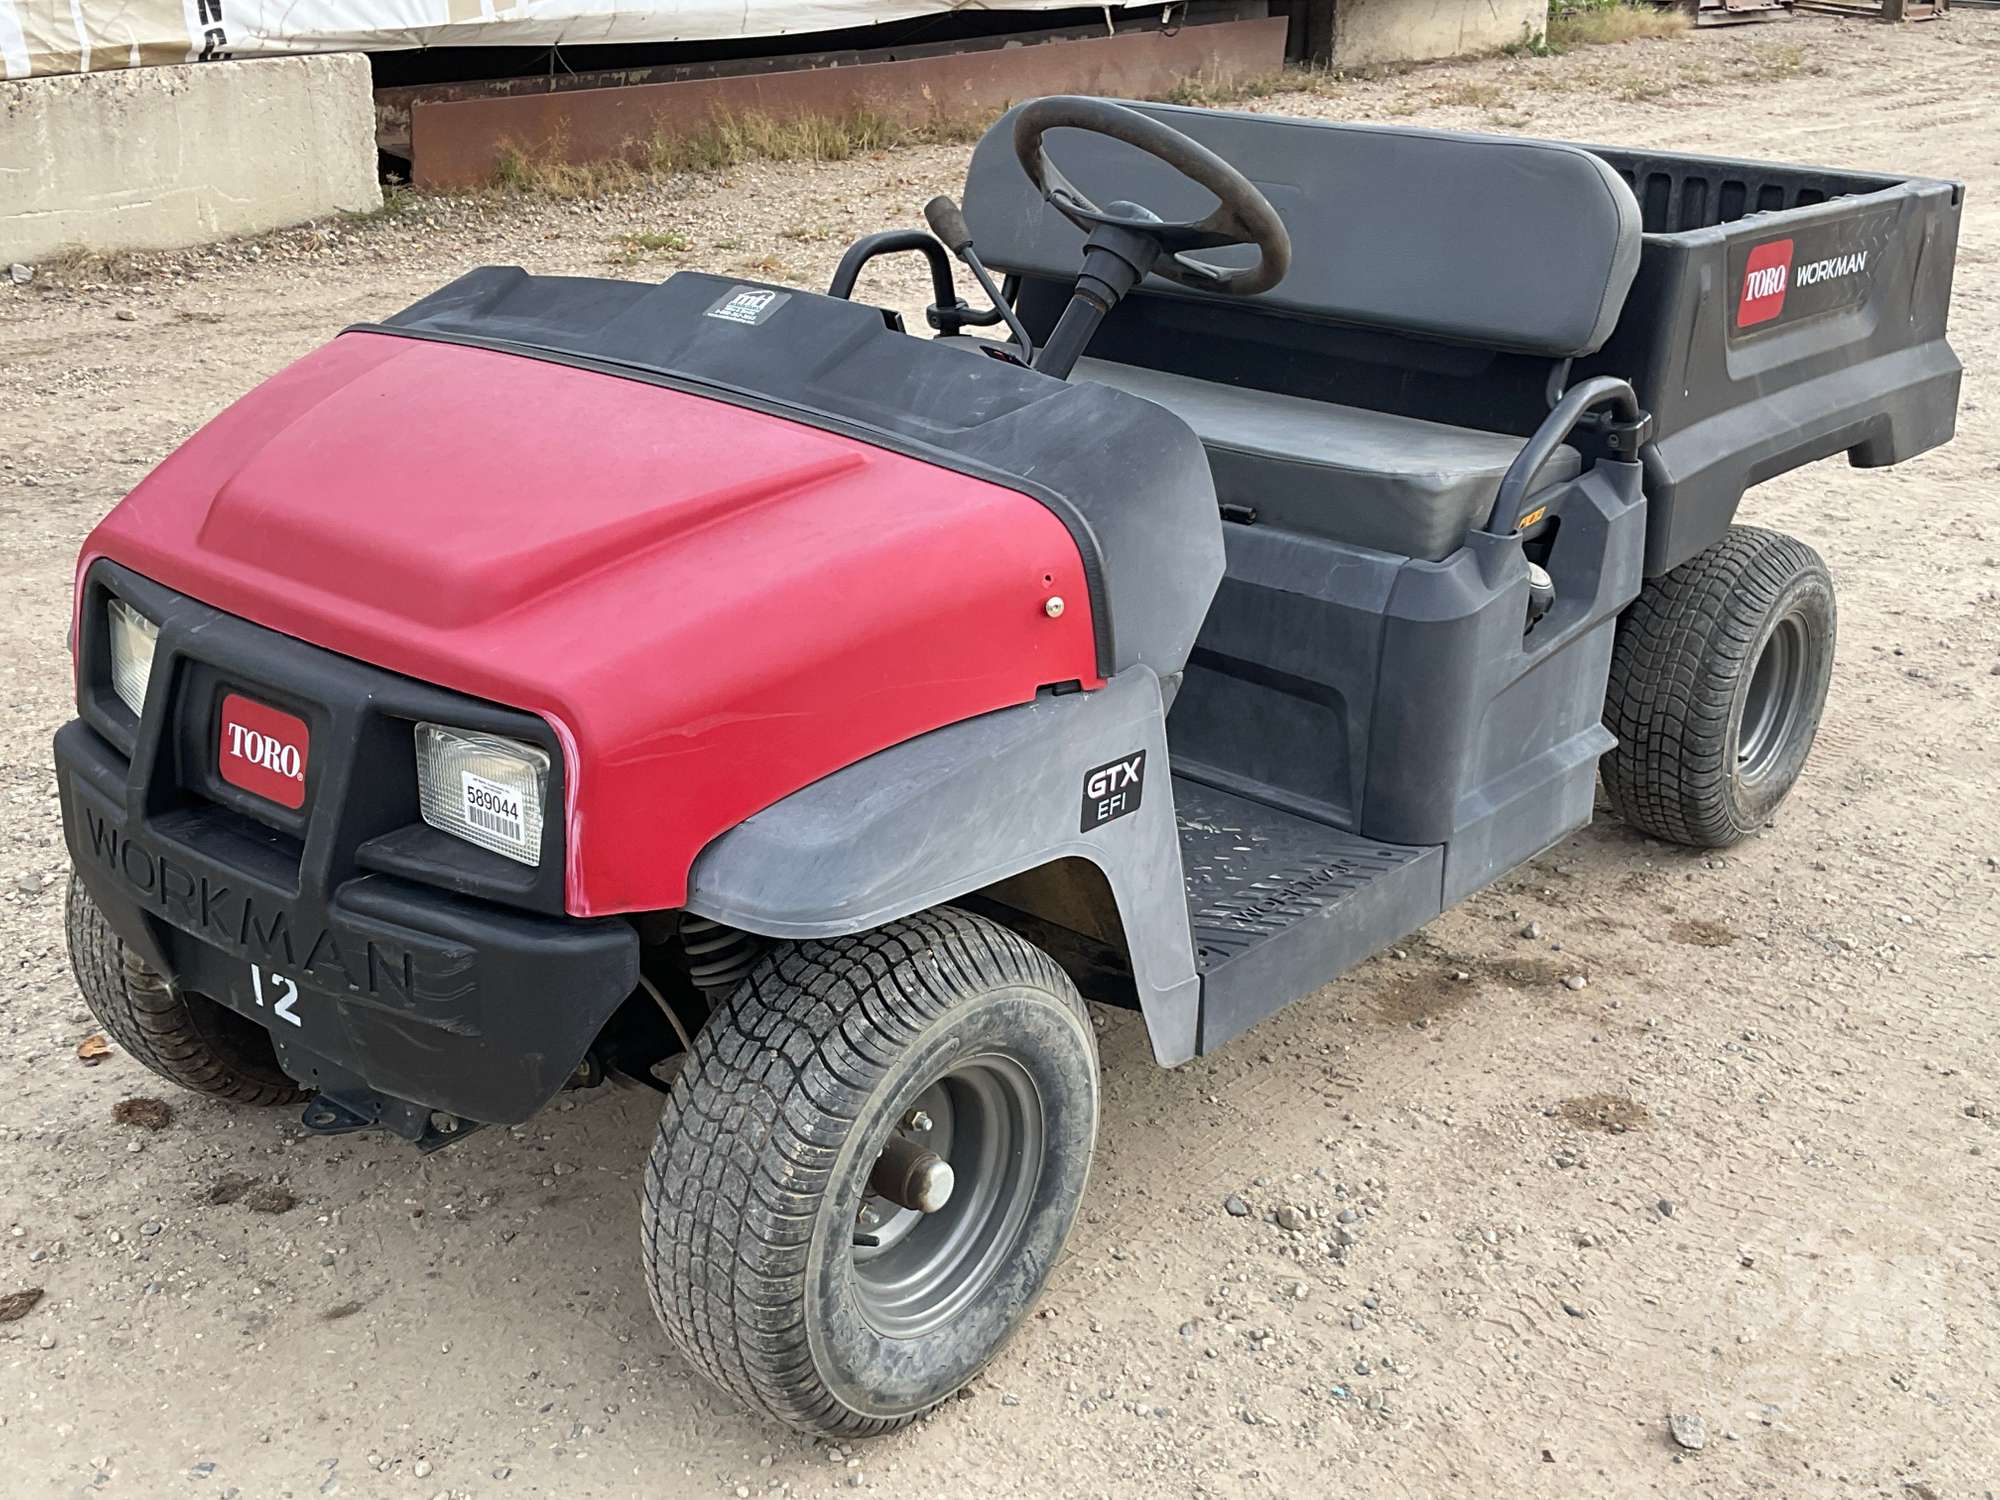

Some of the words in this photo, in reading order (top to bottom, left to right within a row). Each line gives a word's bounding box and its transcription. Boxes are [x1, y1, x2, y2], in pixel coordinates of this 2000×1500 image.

[1745, 265, 1786, 301] TORO
[1796, 251, 1868, 287] WORKMAN
[228, 722, 301, 779] TORO
[467, 785, 519, 820] 589044
[1087, 756, 1142, 799] GTX
[1097, 791, 1127, 820] EFI
[86, 806, 417, 1009] WORKMAN
[251, 962, 303, 1029] 12
